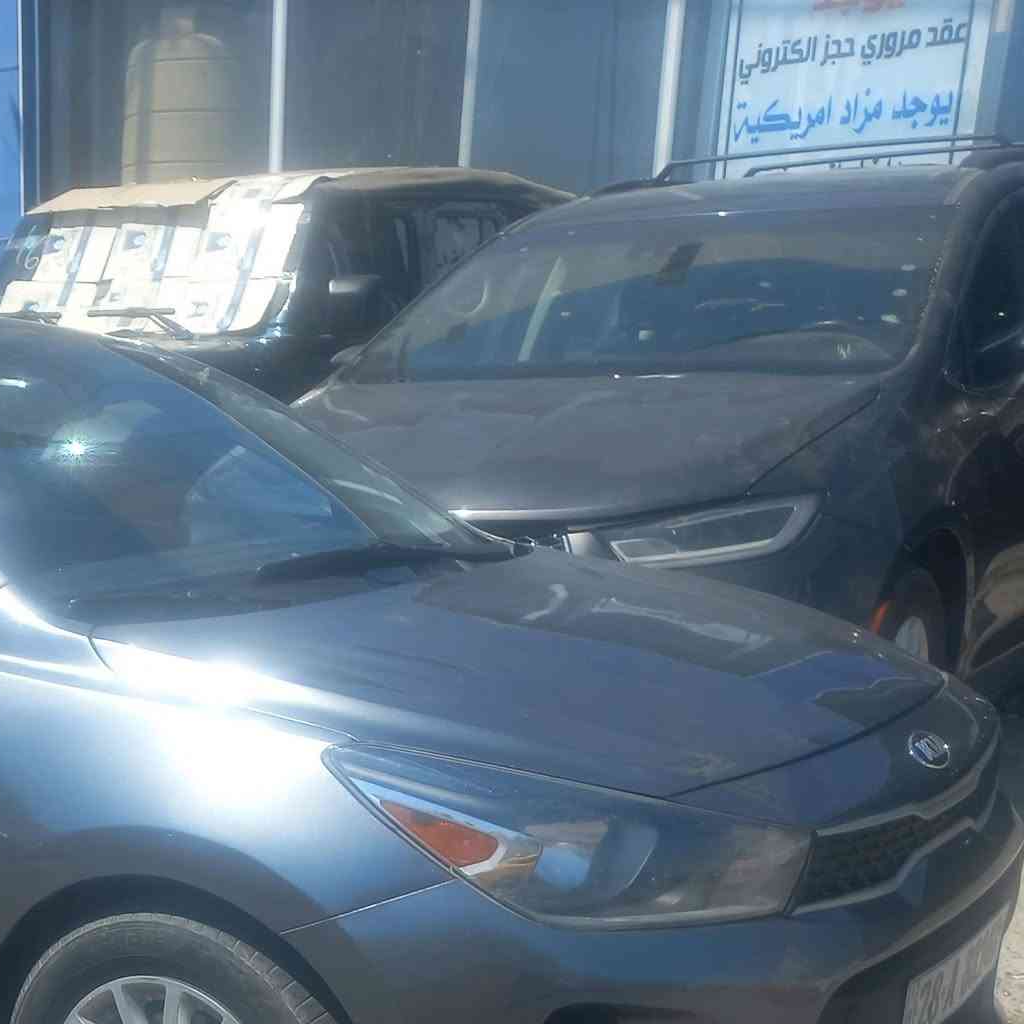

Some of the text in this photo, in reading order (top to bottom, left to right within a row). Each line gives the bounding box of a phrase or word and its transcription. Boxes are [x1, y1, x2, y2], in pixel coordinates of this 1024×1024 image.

[738, 18, 970, 85] عقد مروري حجز الكتروني
[734, 87, 954, 144] يوجد مزاد امريكية
